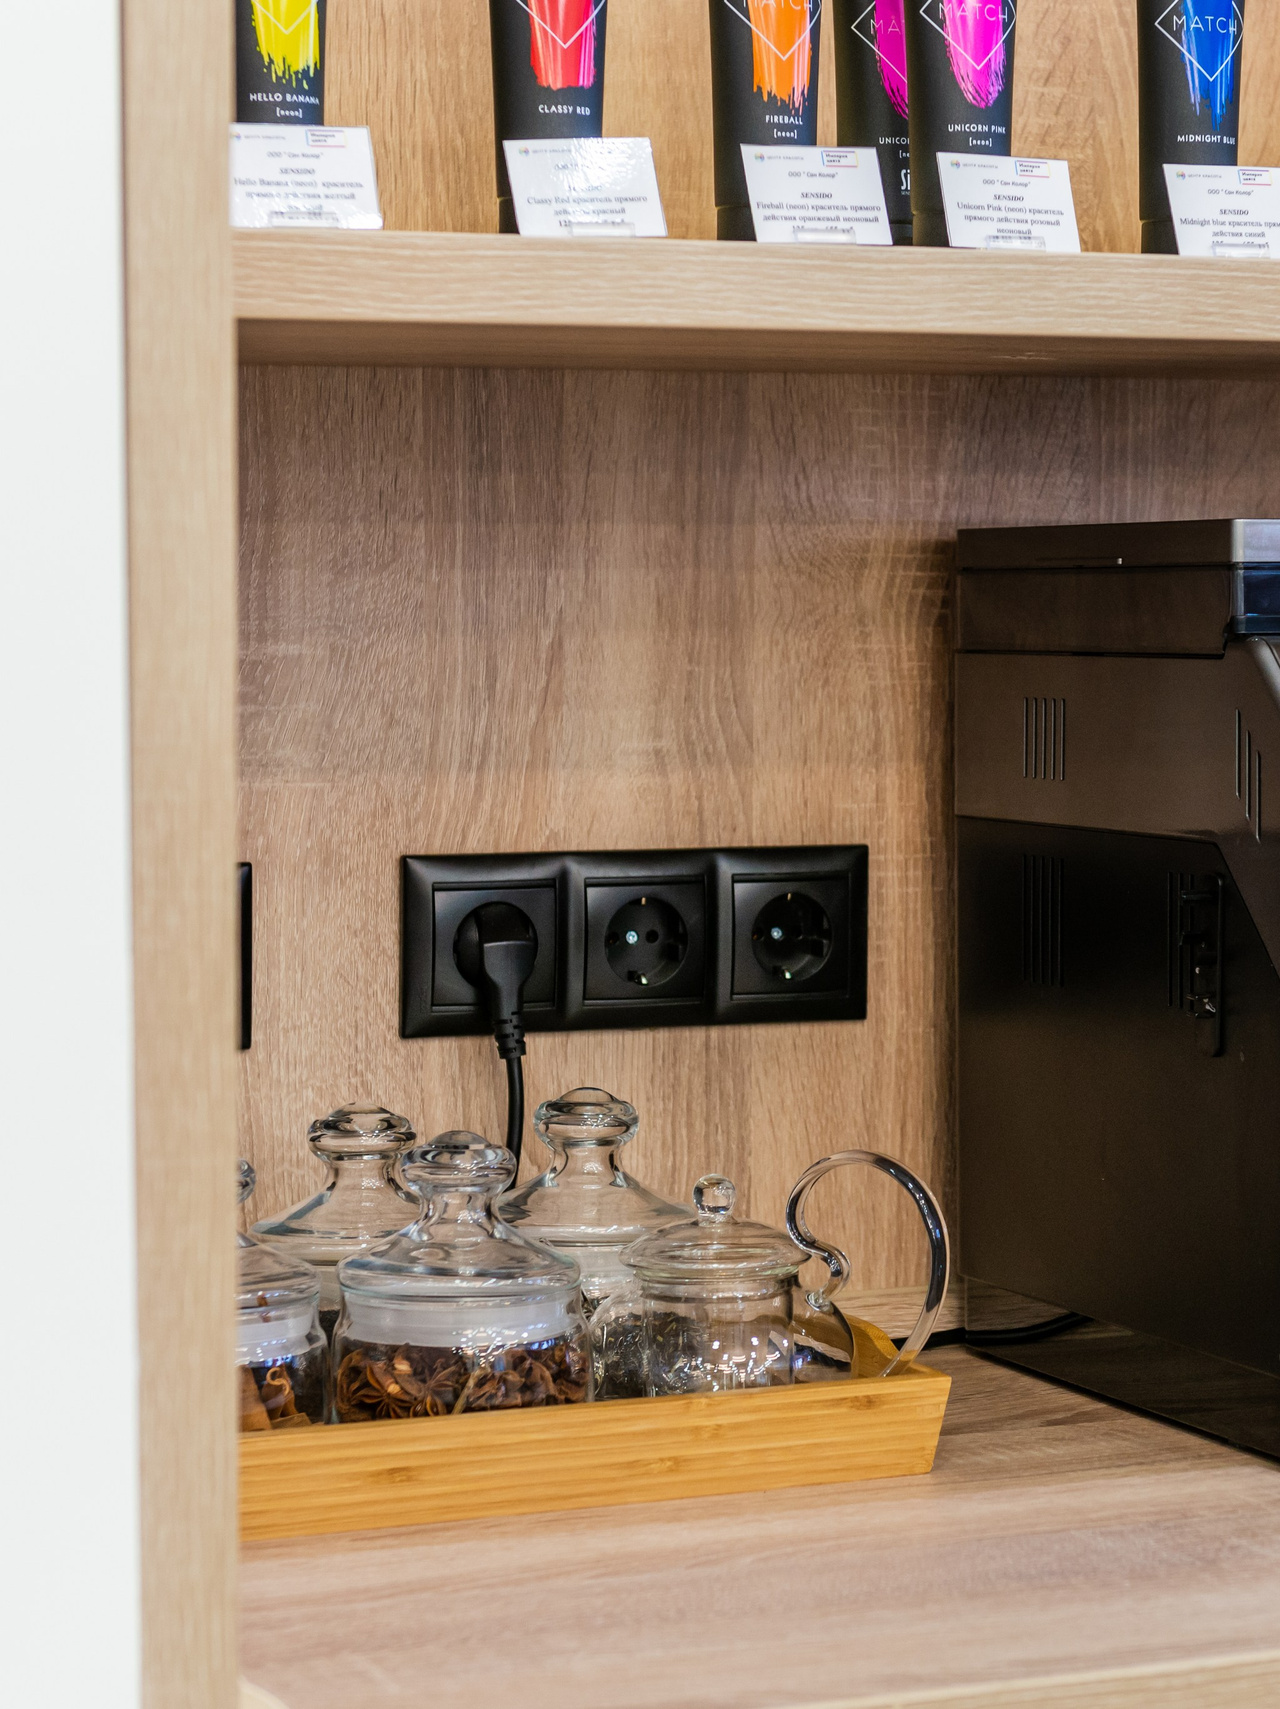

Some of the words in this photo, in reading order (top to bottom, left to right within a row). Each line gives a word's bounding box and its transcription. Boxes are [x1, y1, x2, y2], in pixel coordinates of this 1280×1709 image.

[939, 4, 1008, 22] MATCH
[1173, 15, 1237, 35] MATCH
[250, 92, 283, 102] HELLO
[285, 93, 320, 105] BANANA
[538, 104, 573, 114] CLASSY
[576, 107, 591, 116] RED
[765, 115, 803, 125] FIREBALL
[948, 124, 989, 133] UNICORN
[991, 125, 1007, 134] PINK
[1177, 135, 1221, 143] MIDNIGHT
[1223, 136, 1236, 145] BLUE
[527, 196, 552, 206] Classy
[554, 196, 570, 204] Red
[993, 193, 1024, 202] SENSIDO
[756, 201, 785, 210] Fireball
[786, 202, 809, 211] (neon)
[811, 204, 848, 212] краситель
[850, 205, 881, 213] прямого
[957, 202, 985, 210] Unicorn
[987, 203, 1002, 211] Pink
[1004, 205, 1027, 214] (neon)
[1028, 208, 1064, 216] краситель
[763, 213, 797, 222] действия
[798, 214, 841, 223] оранжевый
[842, 215, 880, 223] неоновый
[964, 214, 995, 222] прямого
[996, 216, 1029, 224] действия
[1030, 217, 1061, 227] розовый
[1180, 217, 1211, 227] Midnight
[1212, 218, 1226, 226] blue
[1228, 220, 1263, 228] краситель
[996, 227, 1032, 236] неоновый
[1212, 230, 1243, 238] действия
[1244, 230, 1266, 238] синий
